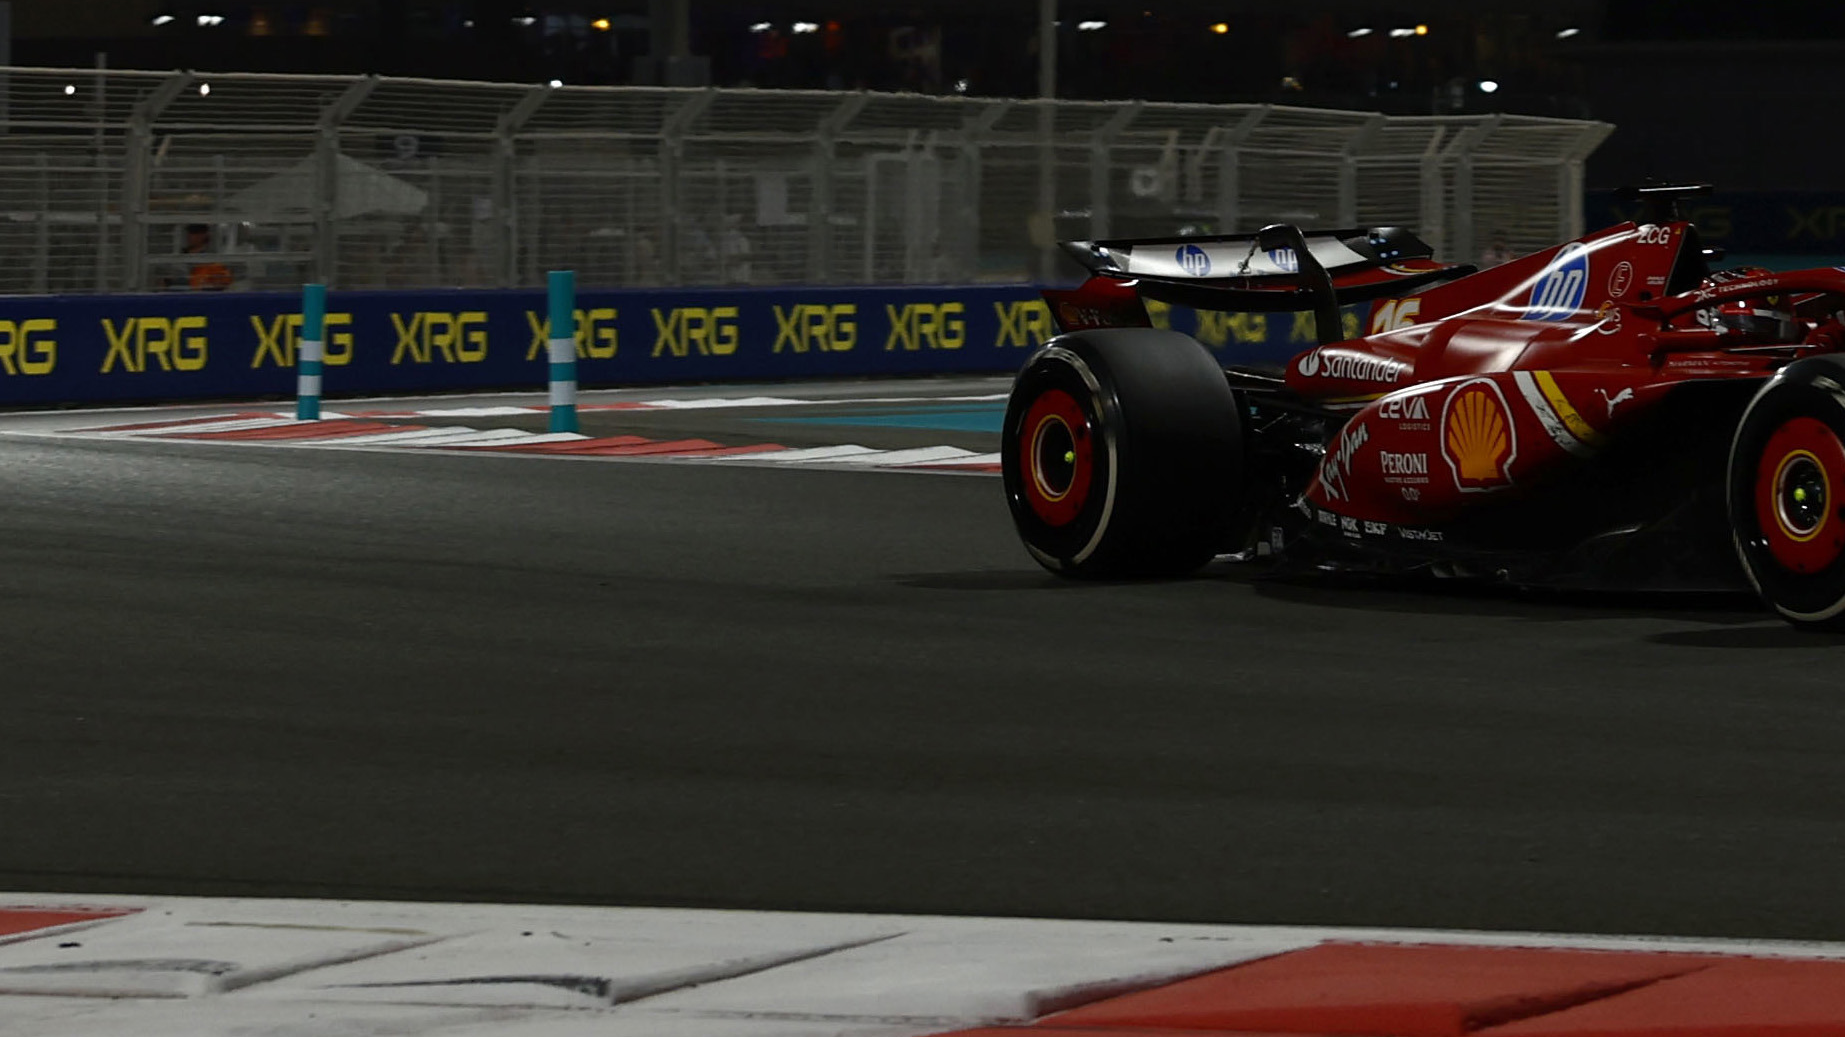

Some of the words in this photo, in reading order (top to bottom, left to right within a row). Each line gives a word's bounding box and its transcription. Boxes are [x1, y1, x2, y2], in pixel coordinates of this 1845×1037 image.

[1182, 245, 1206, 277] hp
[390, 311, 489, 364] XRG
[651, 306, 739, 357] XRG
[772, 303, 858, 353] XRG
[884, 302, 966, 351] XRG
[1371, 297, 1422, 335] 16
[0, 319, 57, 376] RG
[100, 316, 208, 373] XRG
[1321, 355, 1402, 383] Santander
[1380, 450, 1428, 475] PERONI
